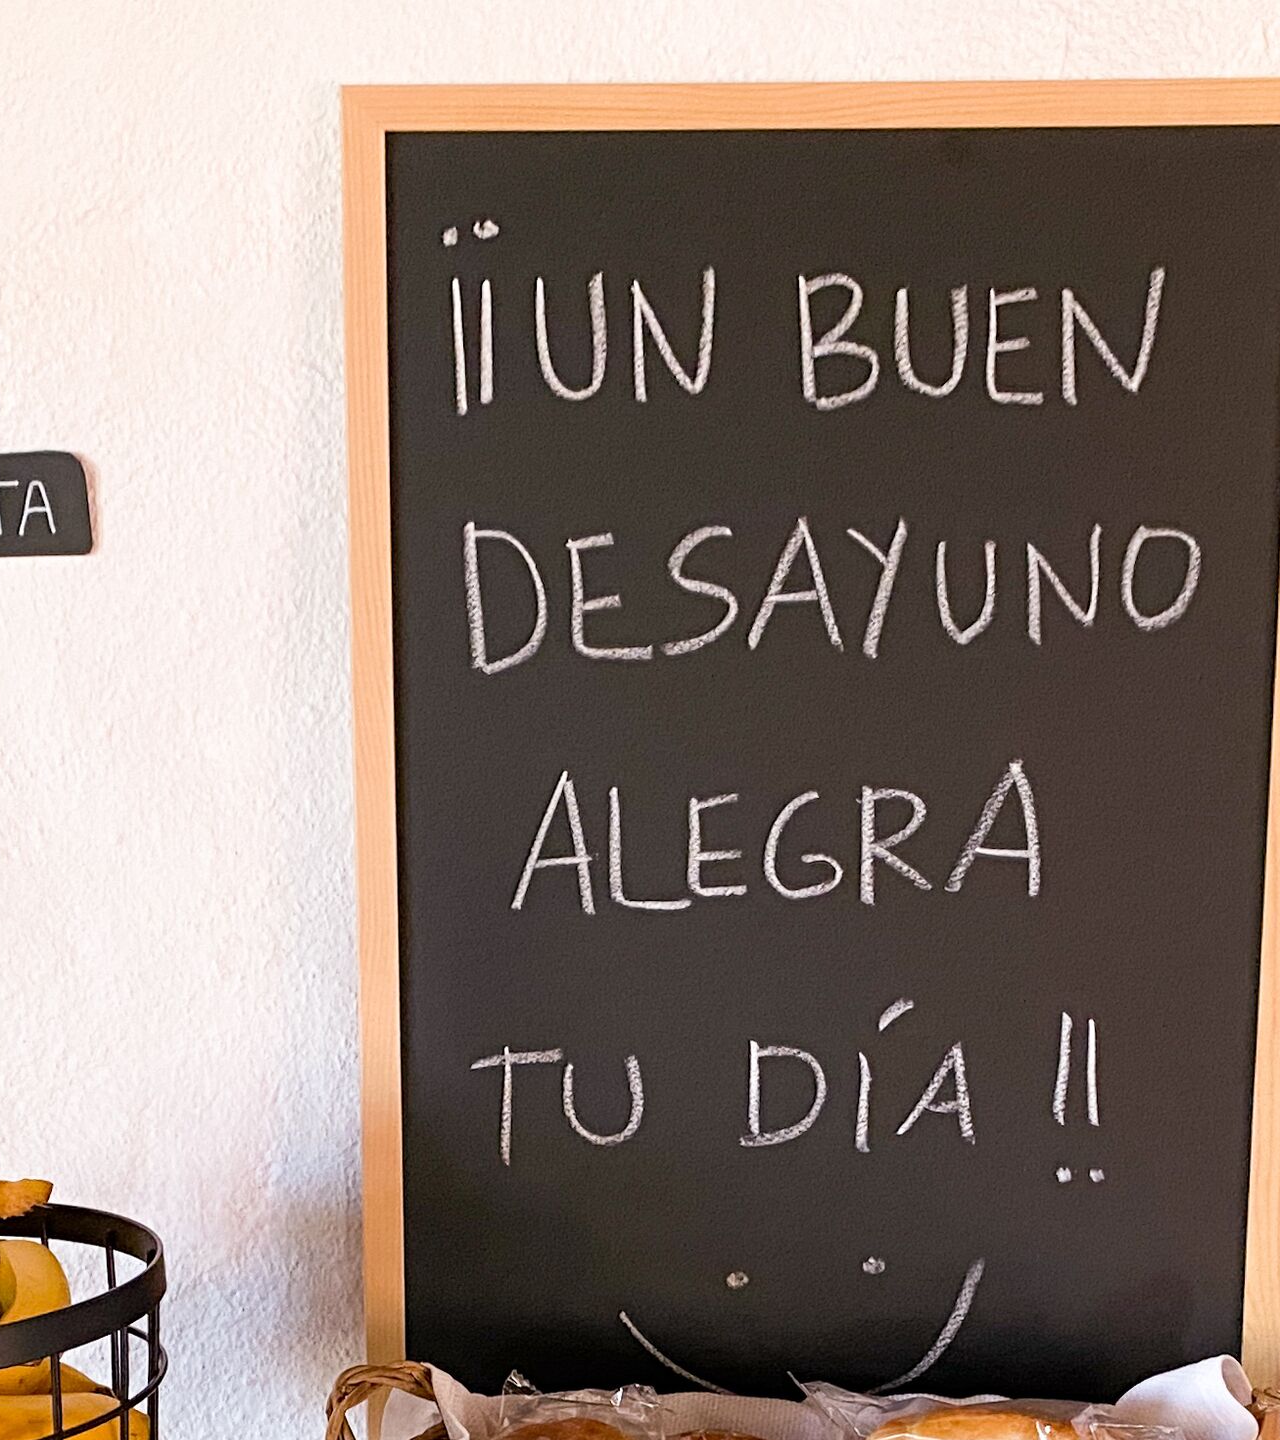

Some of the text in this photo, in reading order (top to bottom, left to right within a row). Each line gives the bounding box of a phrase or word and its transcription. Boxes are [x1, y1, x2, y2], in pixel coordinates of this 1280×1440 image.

[797, 266, 1166, 411] BUEN
[462, 516, 1202, 676] DESAYUNO
[510, 757, 1042, 916] ALEGRA
[469, 1044, 646, 1166] TU
[738, 998, 977, 1153] DÍA
